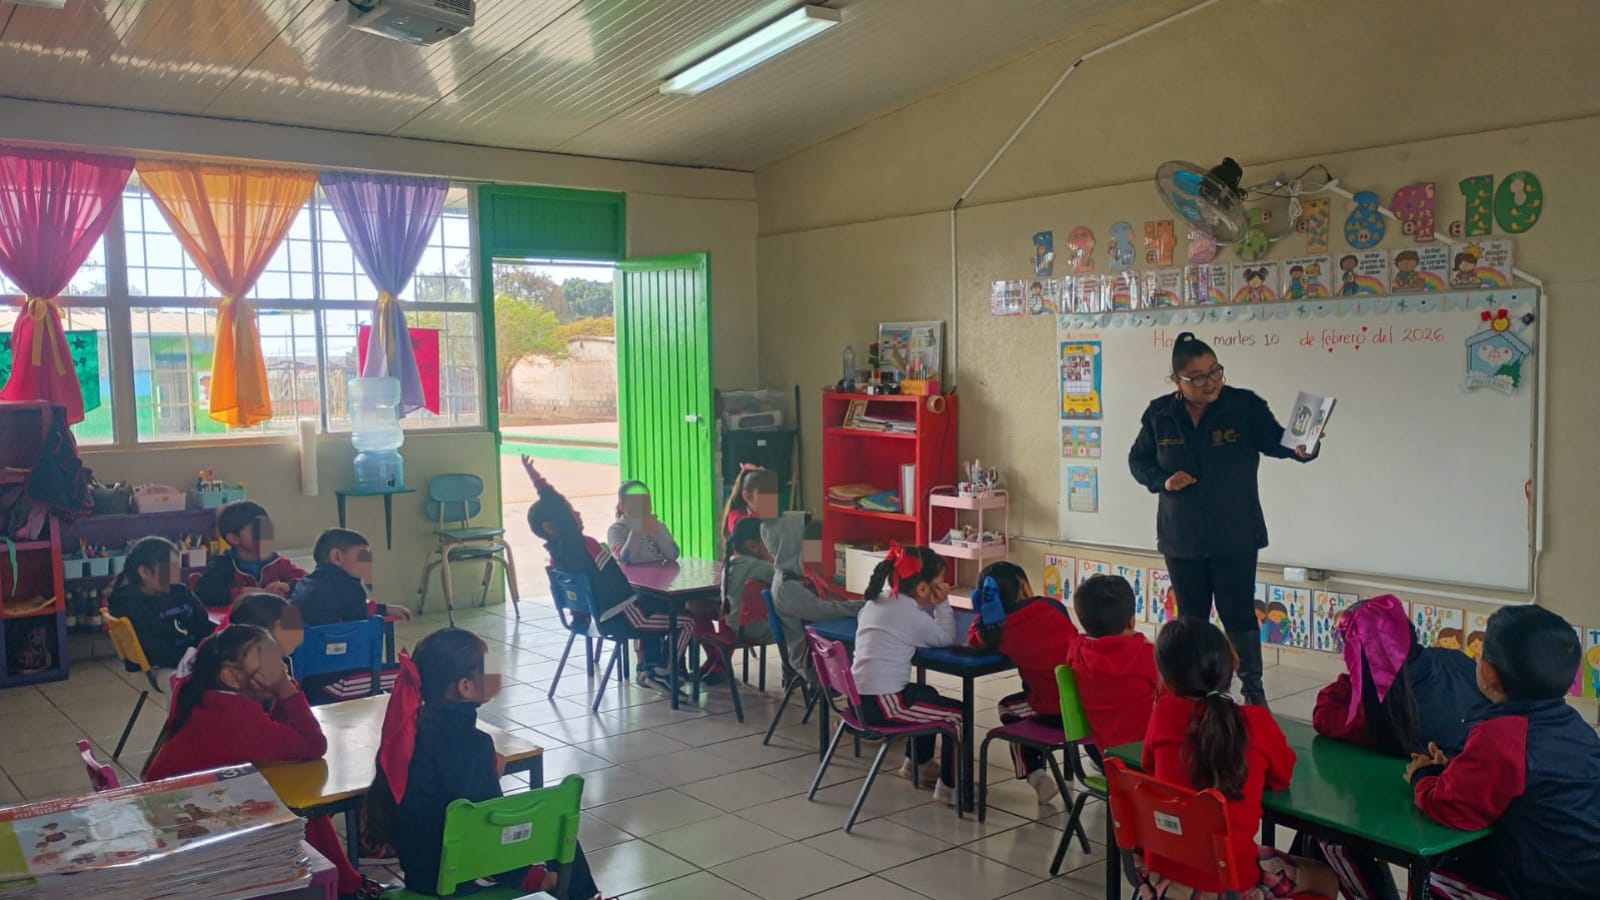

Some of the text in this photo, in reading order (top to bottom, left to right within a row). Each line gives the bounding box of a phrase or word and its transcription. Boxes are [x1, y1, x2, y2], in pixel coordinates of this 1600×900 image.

[1213, 329, 1256, 346] martes
[1264, 333, 1280, 346] 10
[1299, 330, 1315, 346] de
[1321, 327, 1367, 348] febrero
[1372, 325, 1393, 344] del
[1402, 327, 1446, 343] 2026
